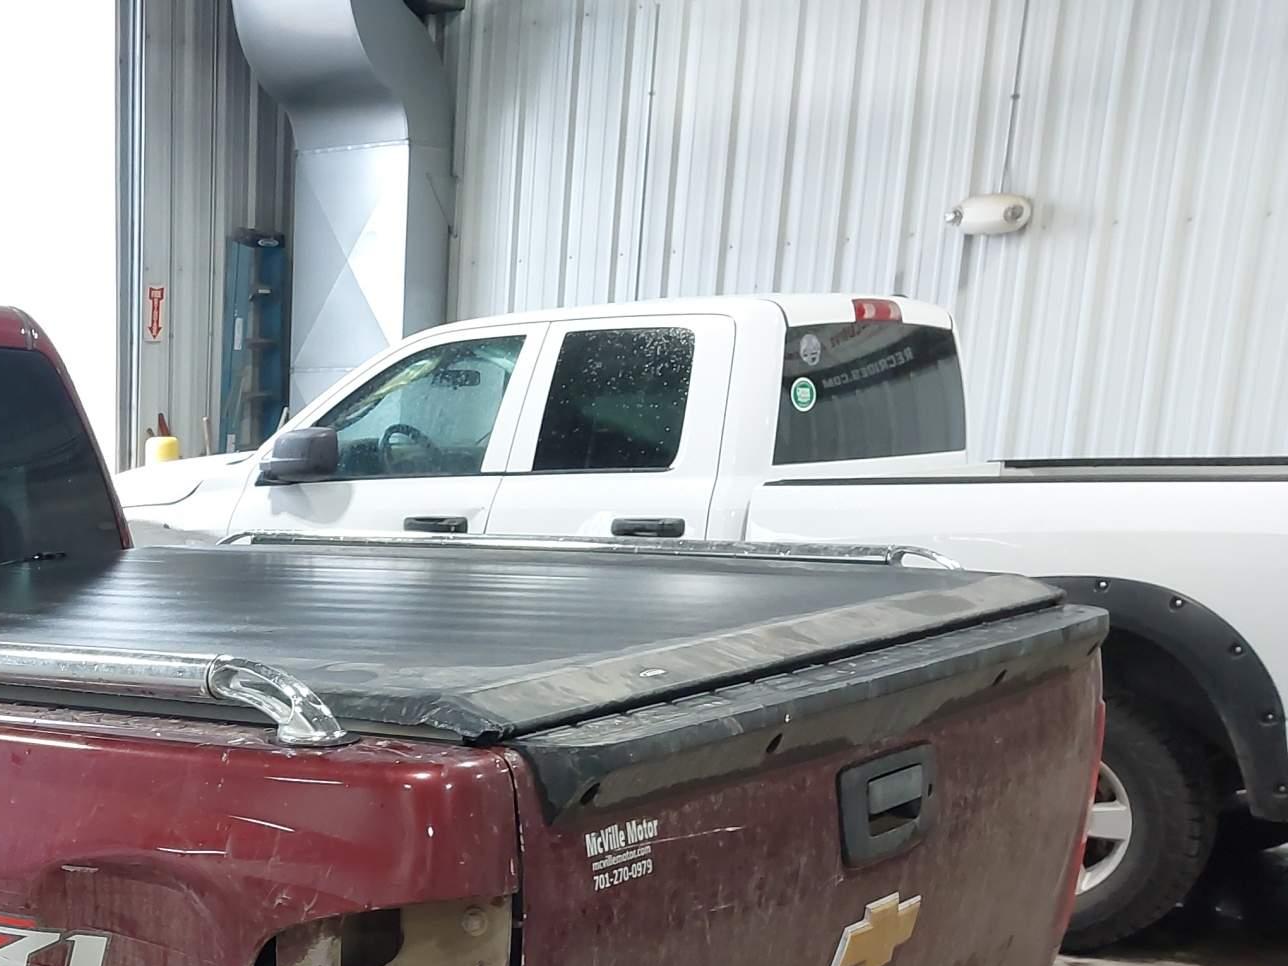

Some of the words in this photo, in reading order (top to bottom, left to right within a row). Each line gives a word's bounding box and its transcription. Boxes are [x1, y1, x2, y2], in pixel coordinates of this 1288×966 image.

[585, 825, 625, 857] McVille
[626, 819, 658, 844] Motor
[592, 845, 651, 871] mcvillemotor.com
[593, 859, 652, 891] 701-270-0979
